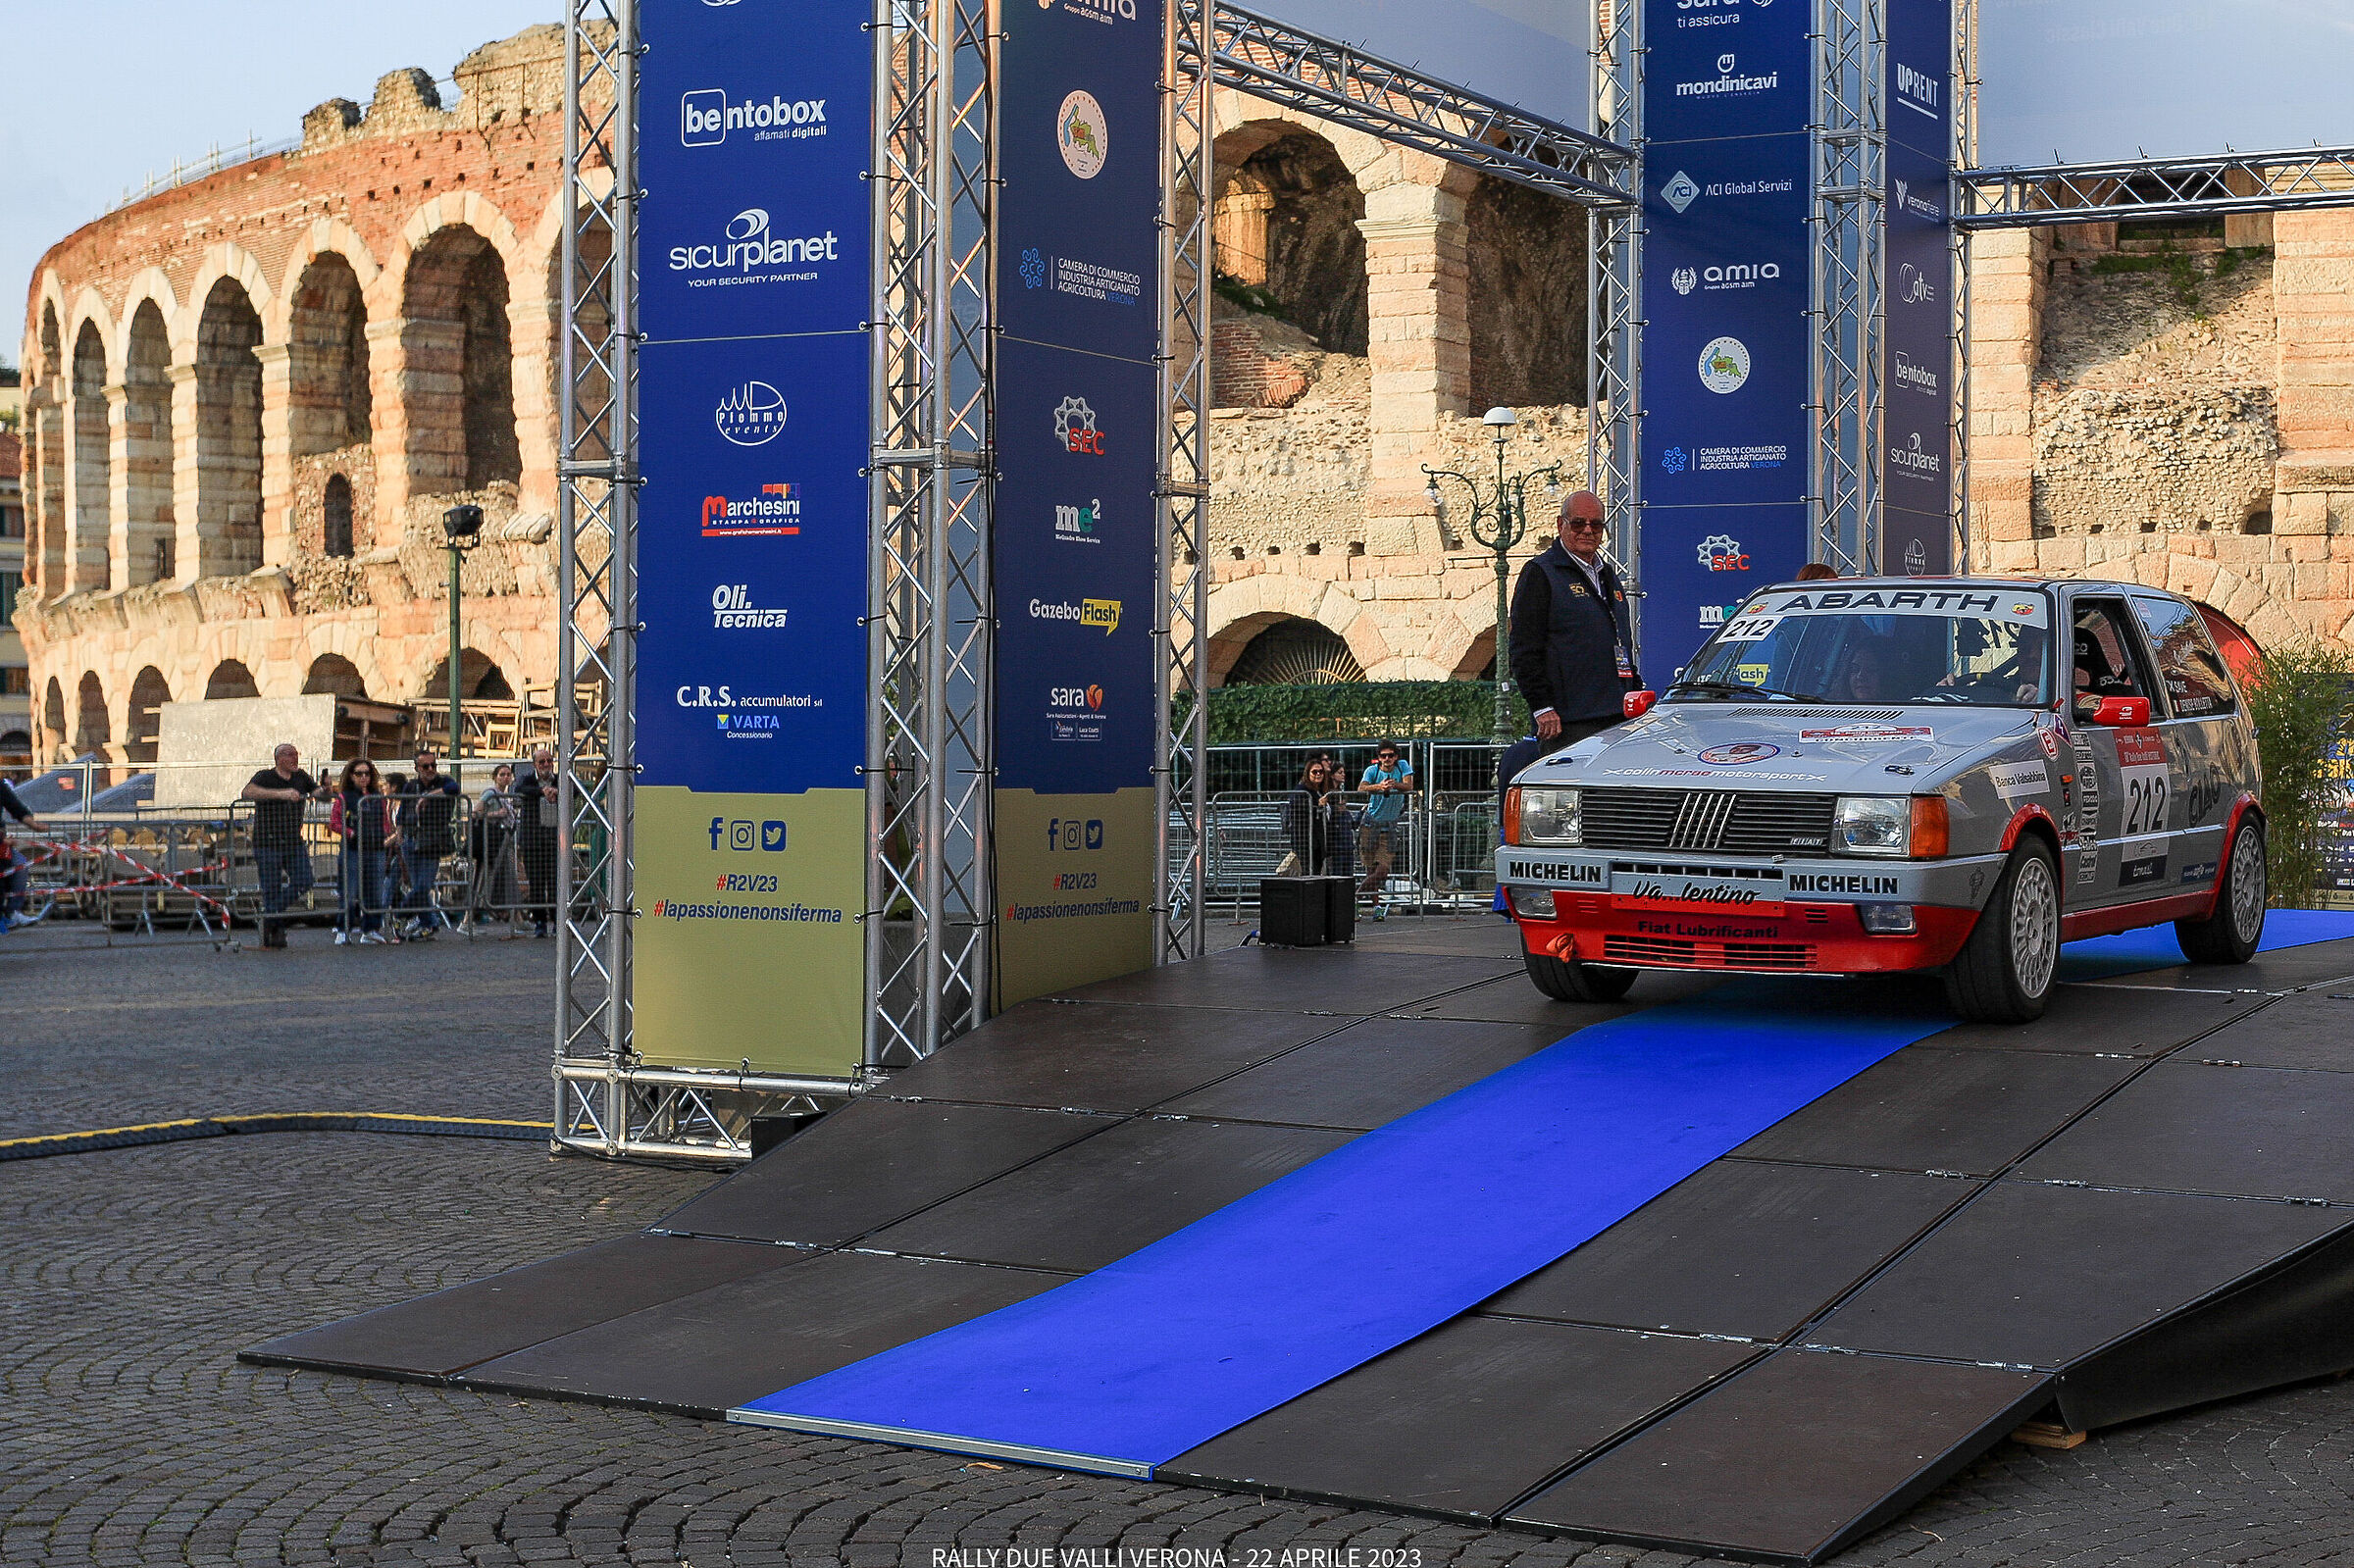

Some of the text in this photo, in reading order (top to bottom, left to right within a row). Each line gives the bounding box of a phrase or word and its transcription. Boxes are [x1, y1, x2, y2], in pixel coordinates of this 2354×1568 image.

[1677, 14, 1740, 27] ti assicura
[1676, 72, 1777, 95] mondinicavi
[686, 96, 826, 134] bentobox
[754, 126, 827, 141] affamati digitali
[1706, 178, 1792, 196] ACI Global Servizi
[1907, 194, 1940, 217] veronafiere
[669, 227, 838, 273] sicurplanet
[688, 272, 818, 287] YOUR SECURITY PARTNER
[1058, 258, 1140, 284] CAMERA DI COMMERCIO
[1058, 270, 1141, 296] INDUSTRIA ARTIGIANATO
[1058, 281, 1136, 306] AGRICOLTURA VERONA
[1897, 359, 1937, 387] bentobox
[1069, 428, 1105, 455] SEC
[1740, 445, 1786, 454] COMMERCIO
[1700, 452, 1786, 463] INDUSTRIA ARTIGIANATO
[1700, 461, 1750, 470] AGRICOLTURA
[701, 495, 800, 527] Marchesini
[1712, 555, 1751, 571] SEC
[1030, 598, 1117, 624] Gazebo Flash
[1776, 591, 2000, 613] ABARTH
[713, 610, 788, 629] Tecnica
[1723, 618, 1774, 638] 212
[676, 686, 736, 707] C.R.S.
[740, 694, 811, 707] accumulatori
[1050, 687, 1084, 706] sara
[733, 715, 780, 730] VARTA
[727, 731, 773, 739] Concessionario
[1995, 770, 2046, 787] Banca Valsabbina
[2126, 777, 2167, 835] 212
[1053, 873, 1097, 891] #R2V23
[1510, 861, 1602, 883] MICHELIN
[716, 873, 778, 892] #R2V23
[1790, 874, 1899, 894] MICHELIN
[653, 898, 842, 925] #lapassionenonsiferma
[1006, 896, 1140, 922] #lapassionenonsiferma
[1638, 921, 1778, 937] Fiat Lubrificanti
